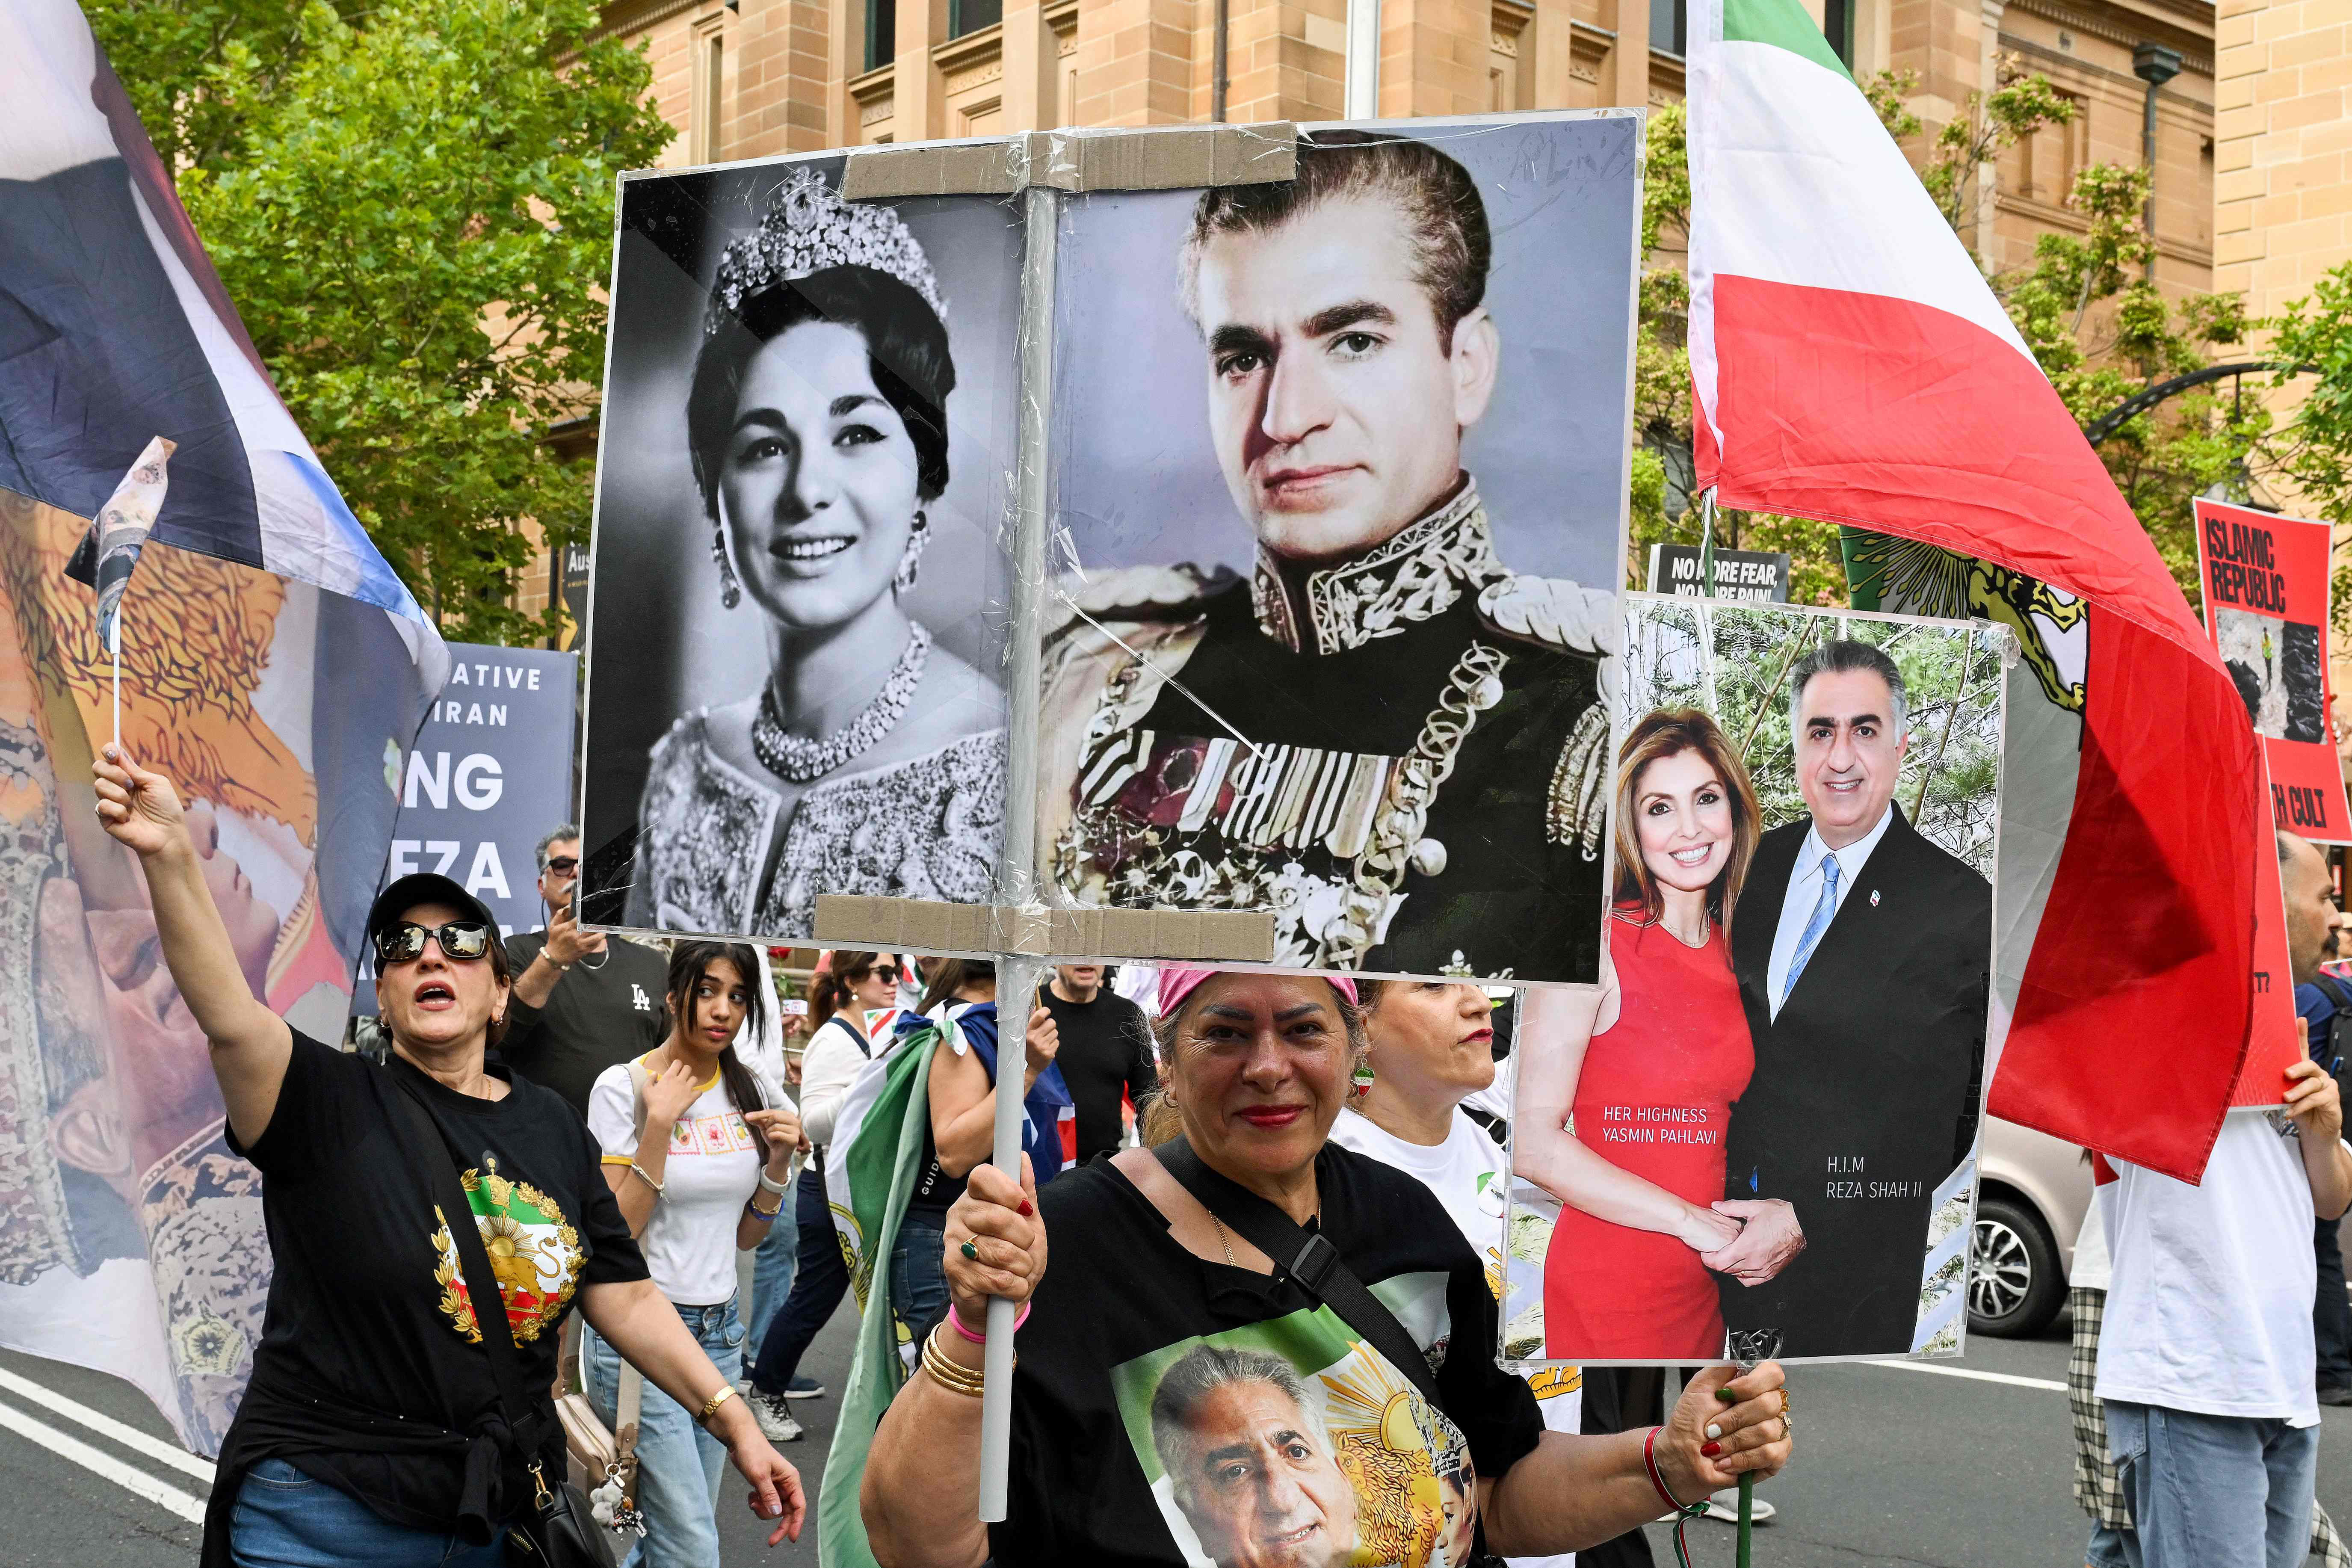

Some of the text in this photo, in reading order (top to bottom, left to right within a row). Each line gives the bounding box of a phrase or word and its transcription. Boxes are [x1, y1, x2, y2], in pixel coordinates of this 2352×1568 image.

[2205, 518, 2275, 570] ISLAMIC
[1672, 557, 1778, 588] NO ORE FEAR,
[2210, 560, 2286, 613] REPUBLIC
[451, 663, 540, 690] ATIVE
[434, 700, 507, 726] IRAN
[2289, 785, 2327, 828] CULT
[385, 840, 512, 899] EZA
[631, 984, 651, 1011] LA
[1604, 1106, 1707, 1123] HER HIGHNESS
[1603, 1127, 1716, 1145] YASMIN PAHLAVI
[1828, 1156, 1864, 1173] H.I.M
[1826, 1181, 1922, 1198] REZA SHAH II
